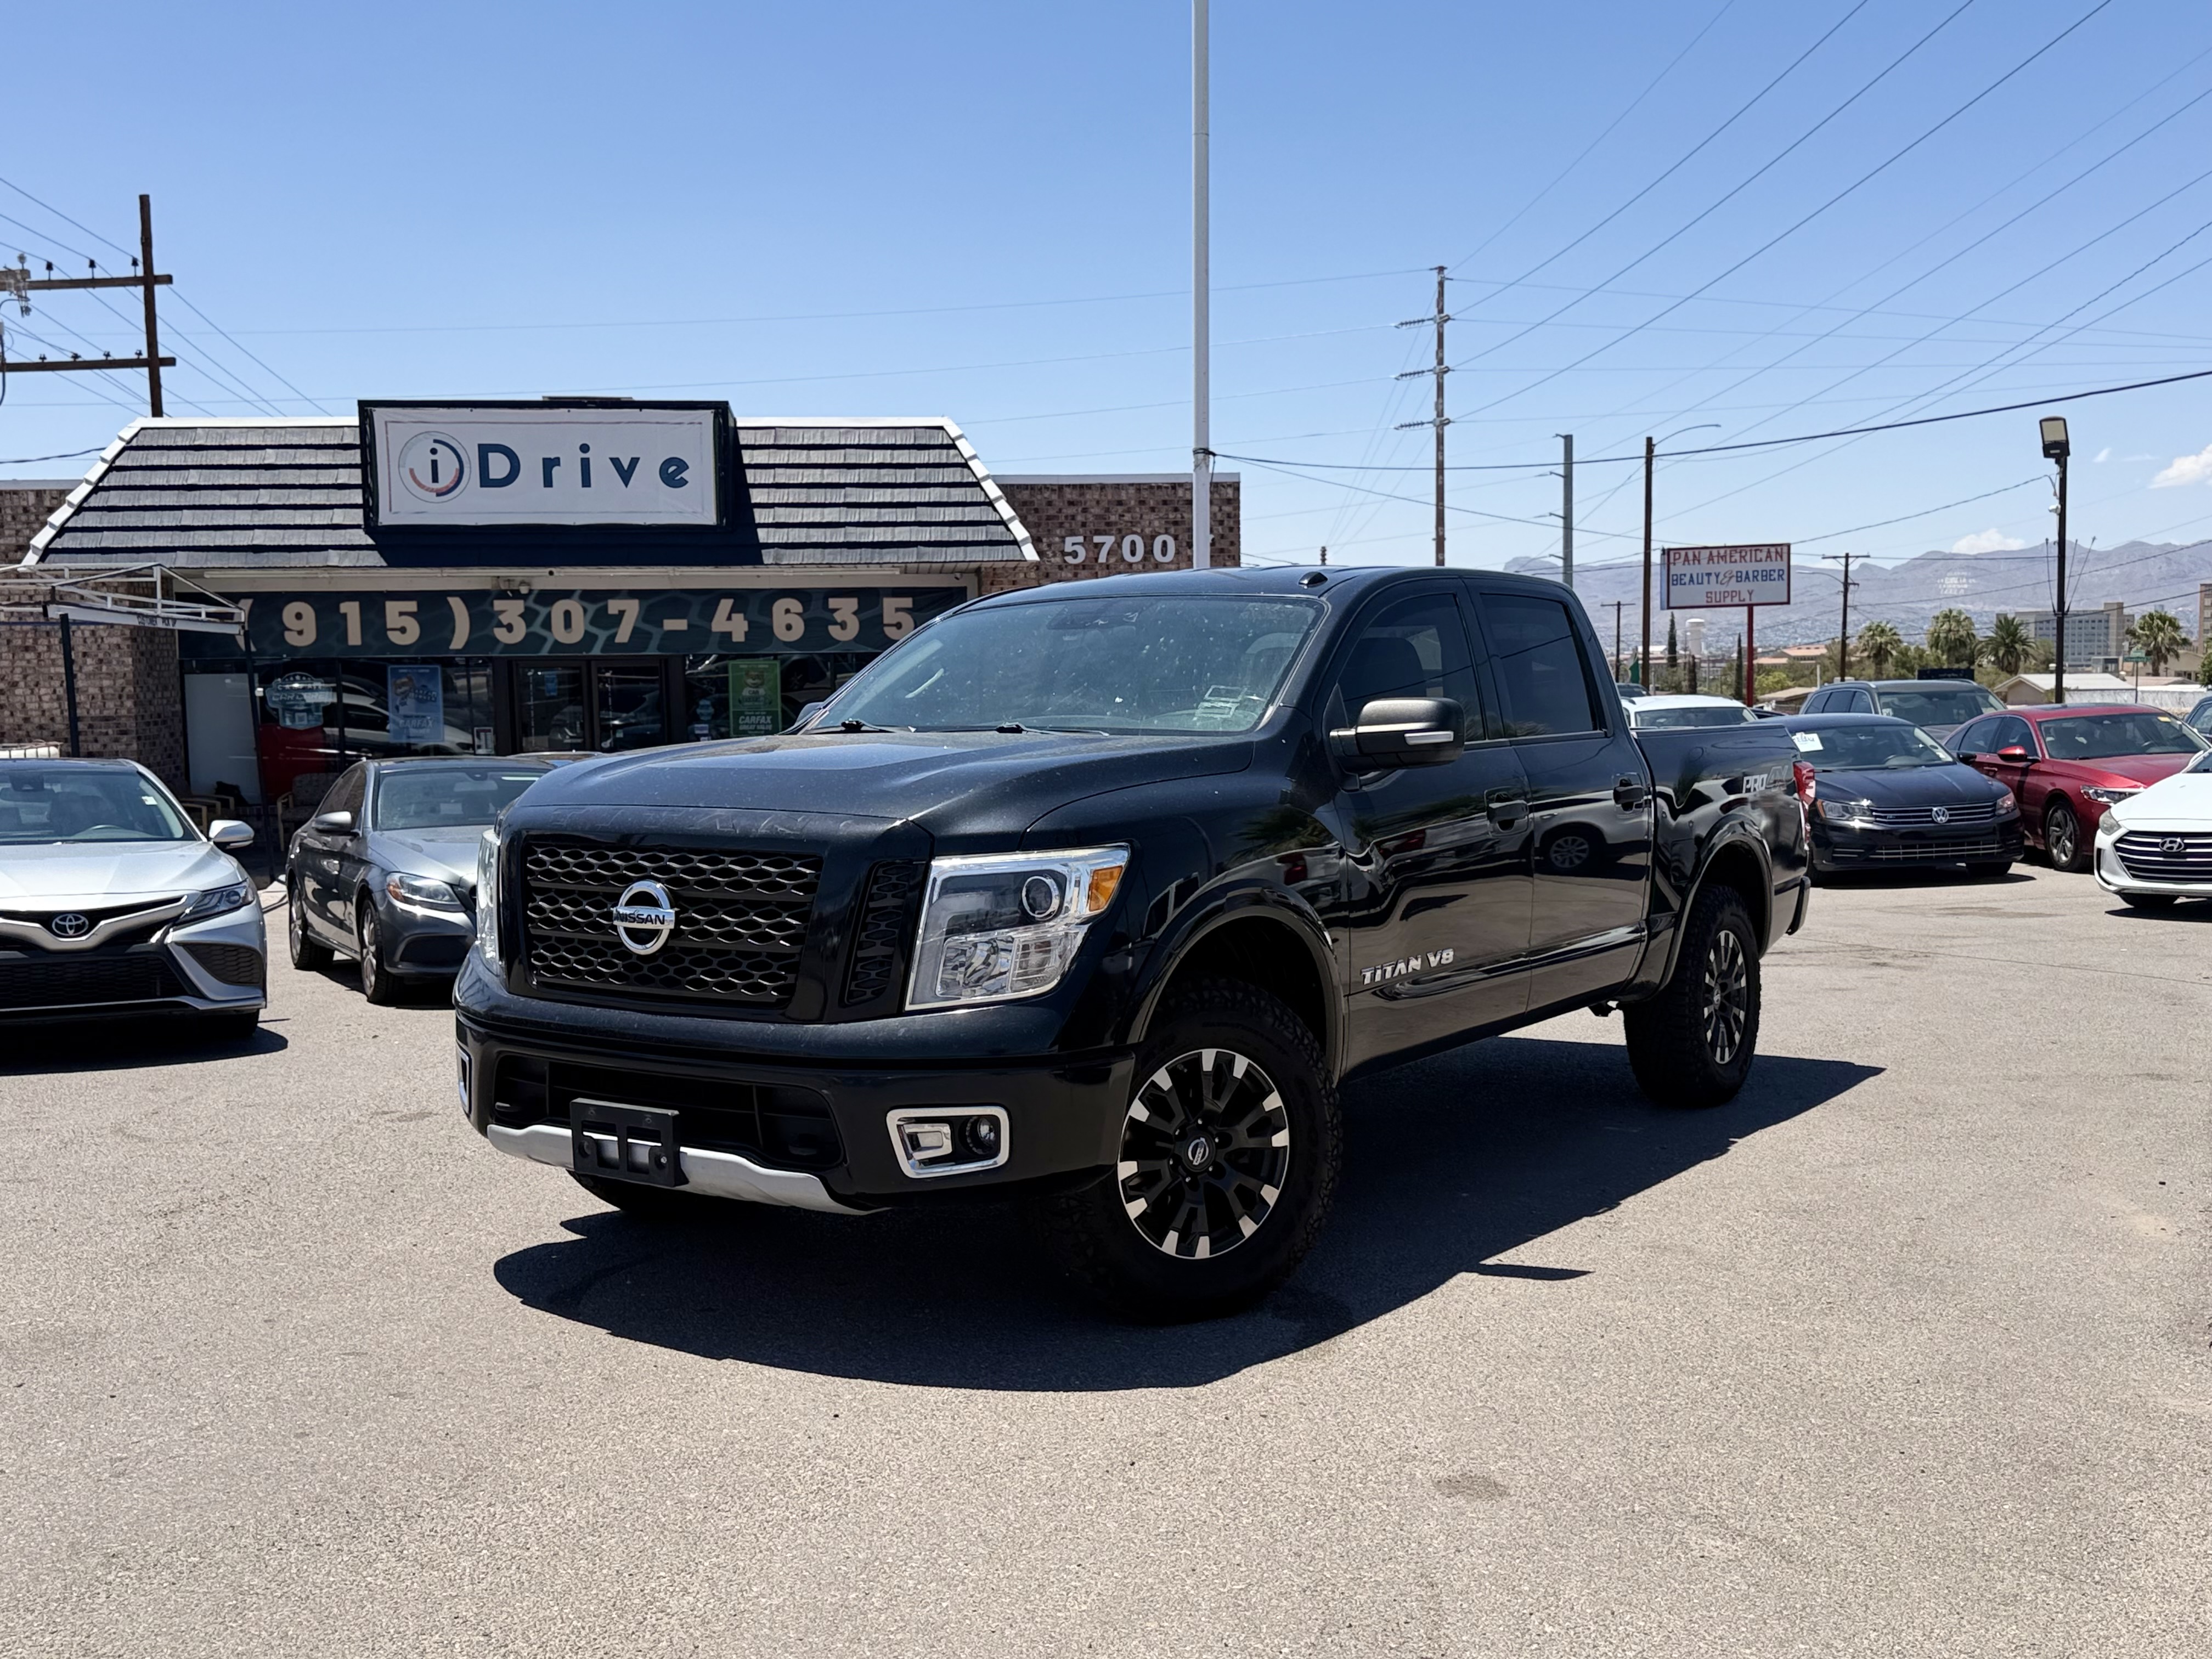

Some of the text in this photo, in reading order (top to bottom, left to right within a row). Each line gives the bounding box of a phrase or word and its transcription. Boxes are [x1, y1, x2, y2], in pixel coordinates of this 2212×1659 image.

[1063, 534, 1176, 564] 5700
[1672, 547, 1784, 566] PAN AMERICAN
[1671, 572, 1721, 586] BEAUTY
[1735, 568, 1785, 583] BARBER
[1706, 589, 1754, 603] SUPPLY
[399, 719, 433, 728] CARFAX
[738, 715, 772, 724] CARFAX
[614, 910, 665, 925] NISSAN
[1361, 948, 1454, 985] TITAN V8
